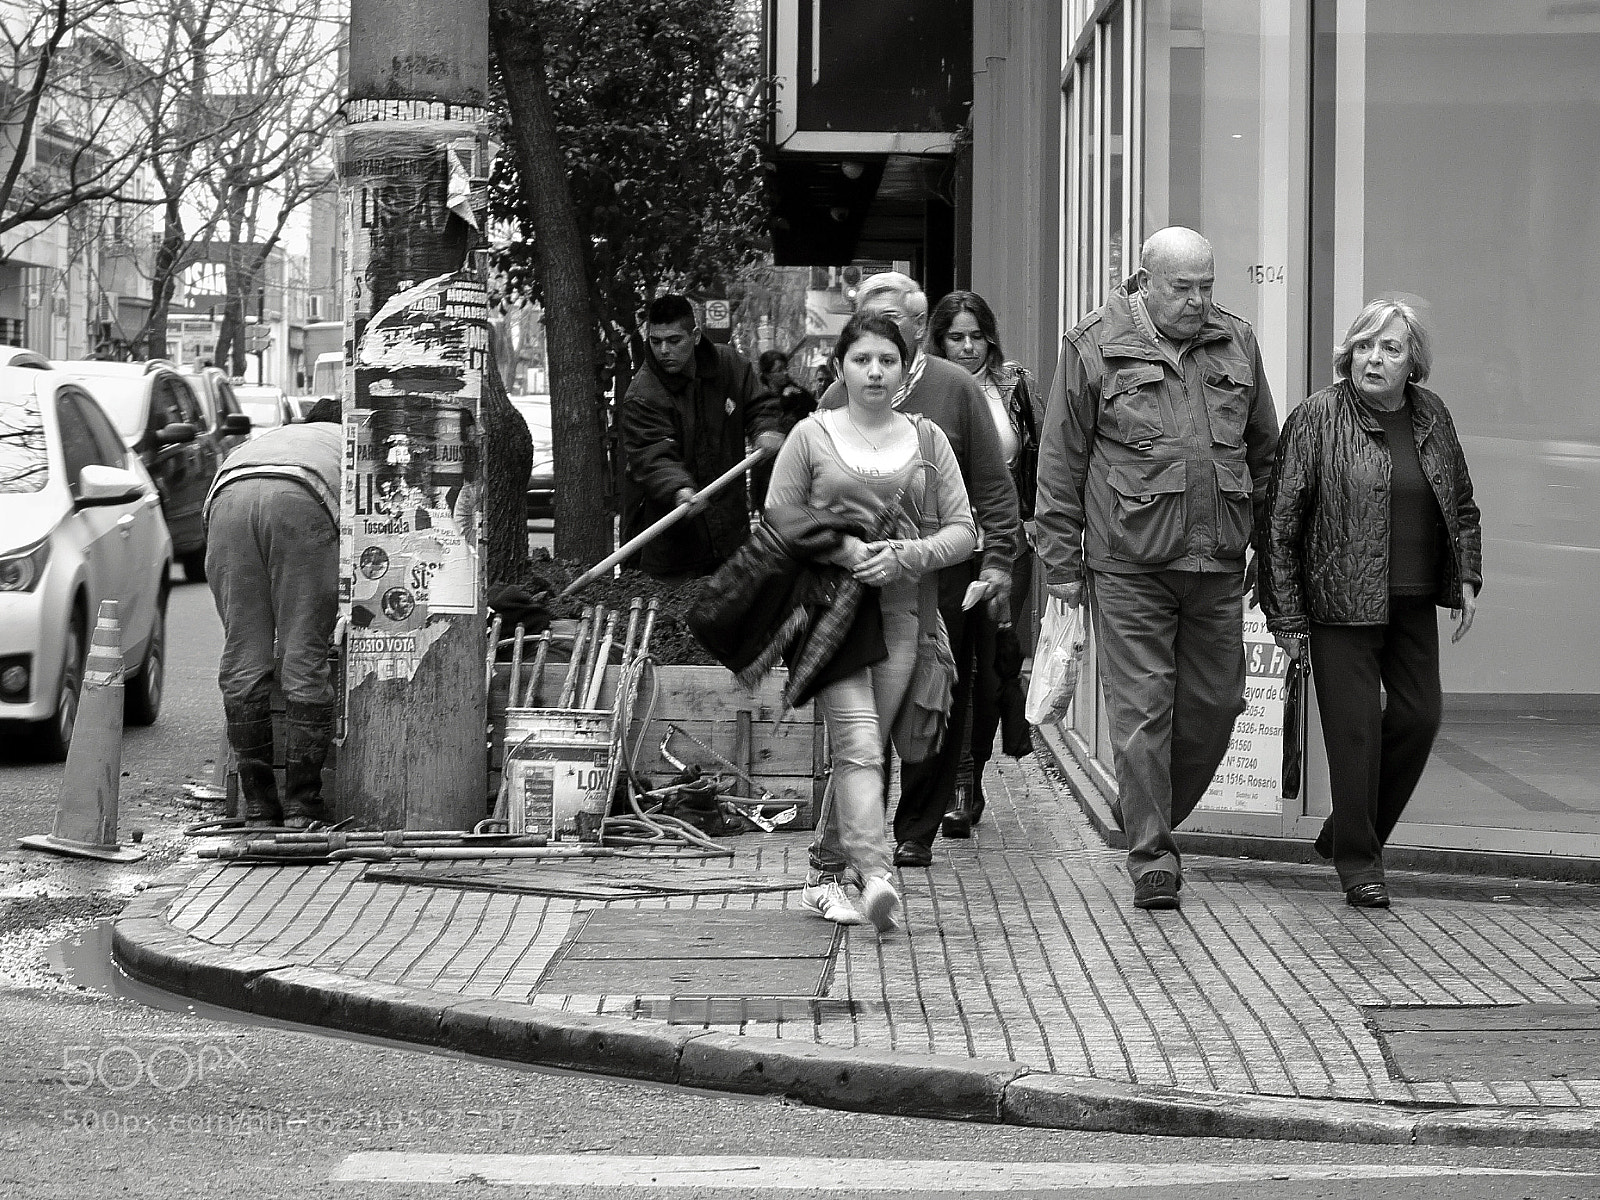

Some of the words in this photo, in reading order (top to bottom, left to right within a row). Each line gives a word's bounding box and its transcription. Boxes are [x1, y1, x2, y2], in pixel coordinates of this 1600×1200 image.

[1247, 265, 1284, 284] 1504
[386, 637, 416, 652] VOTA
[1245, 686, 1265, 701] ayor
[1266, 684, 1277, 700] de
[1236, 757, 1258, 770] 57240
[1247, 775, 1278, 789] Rosario
